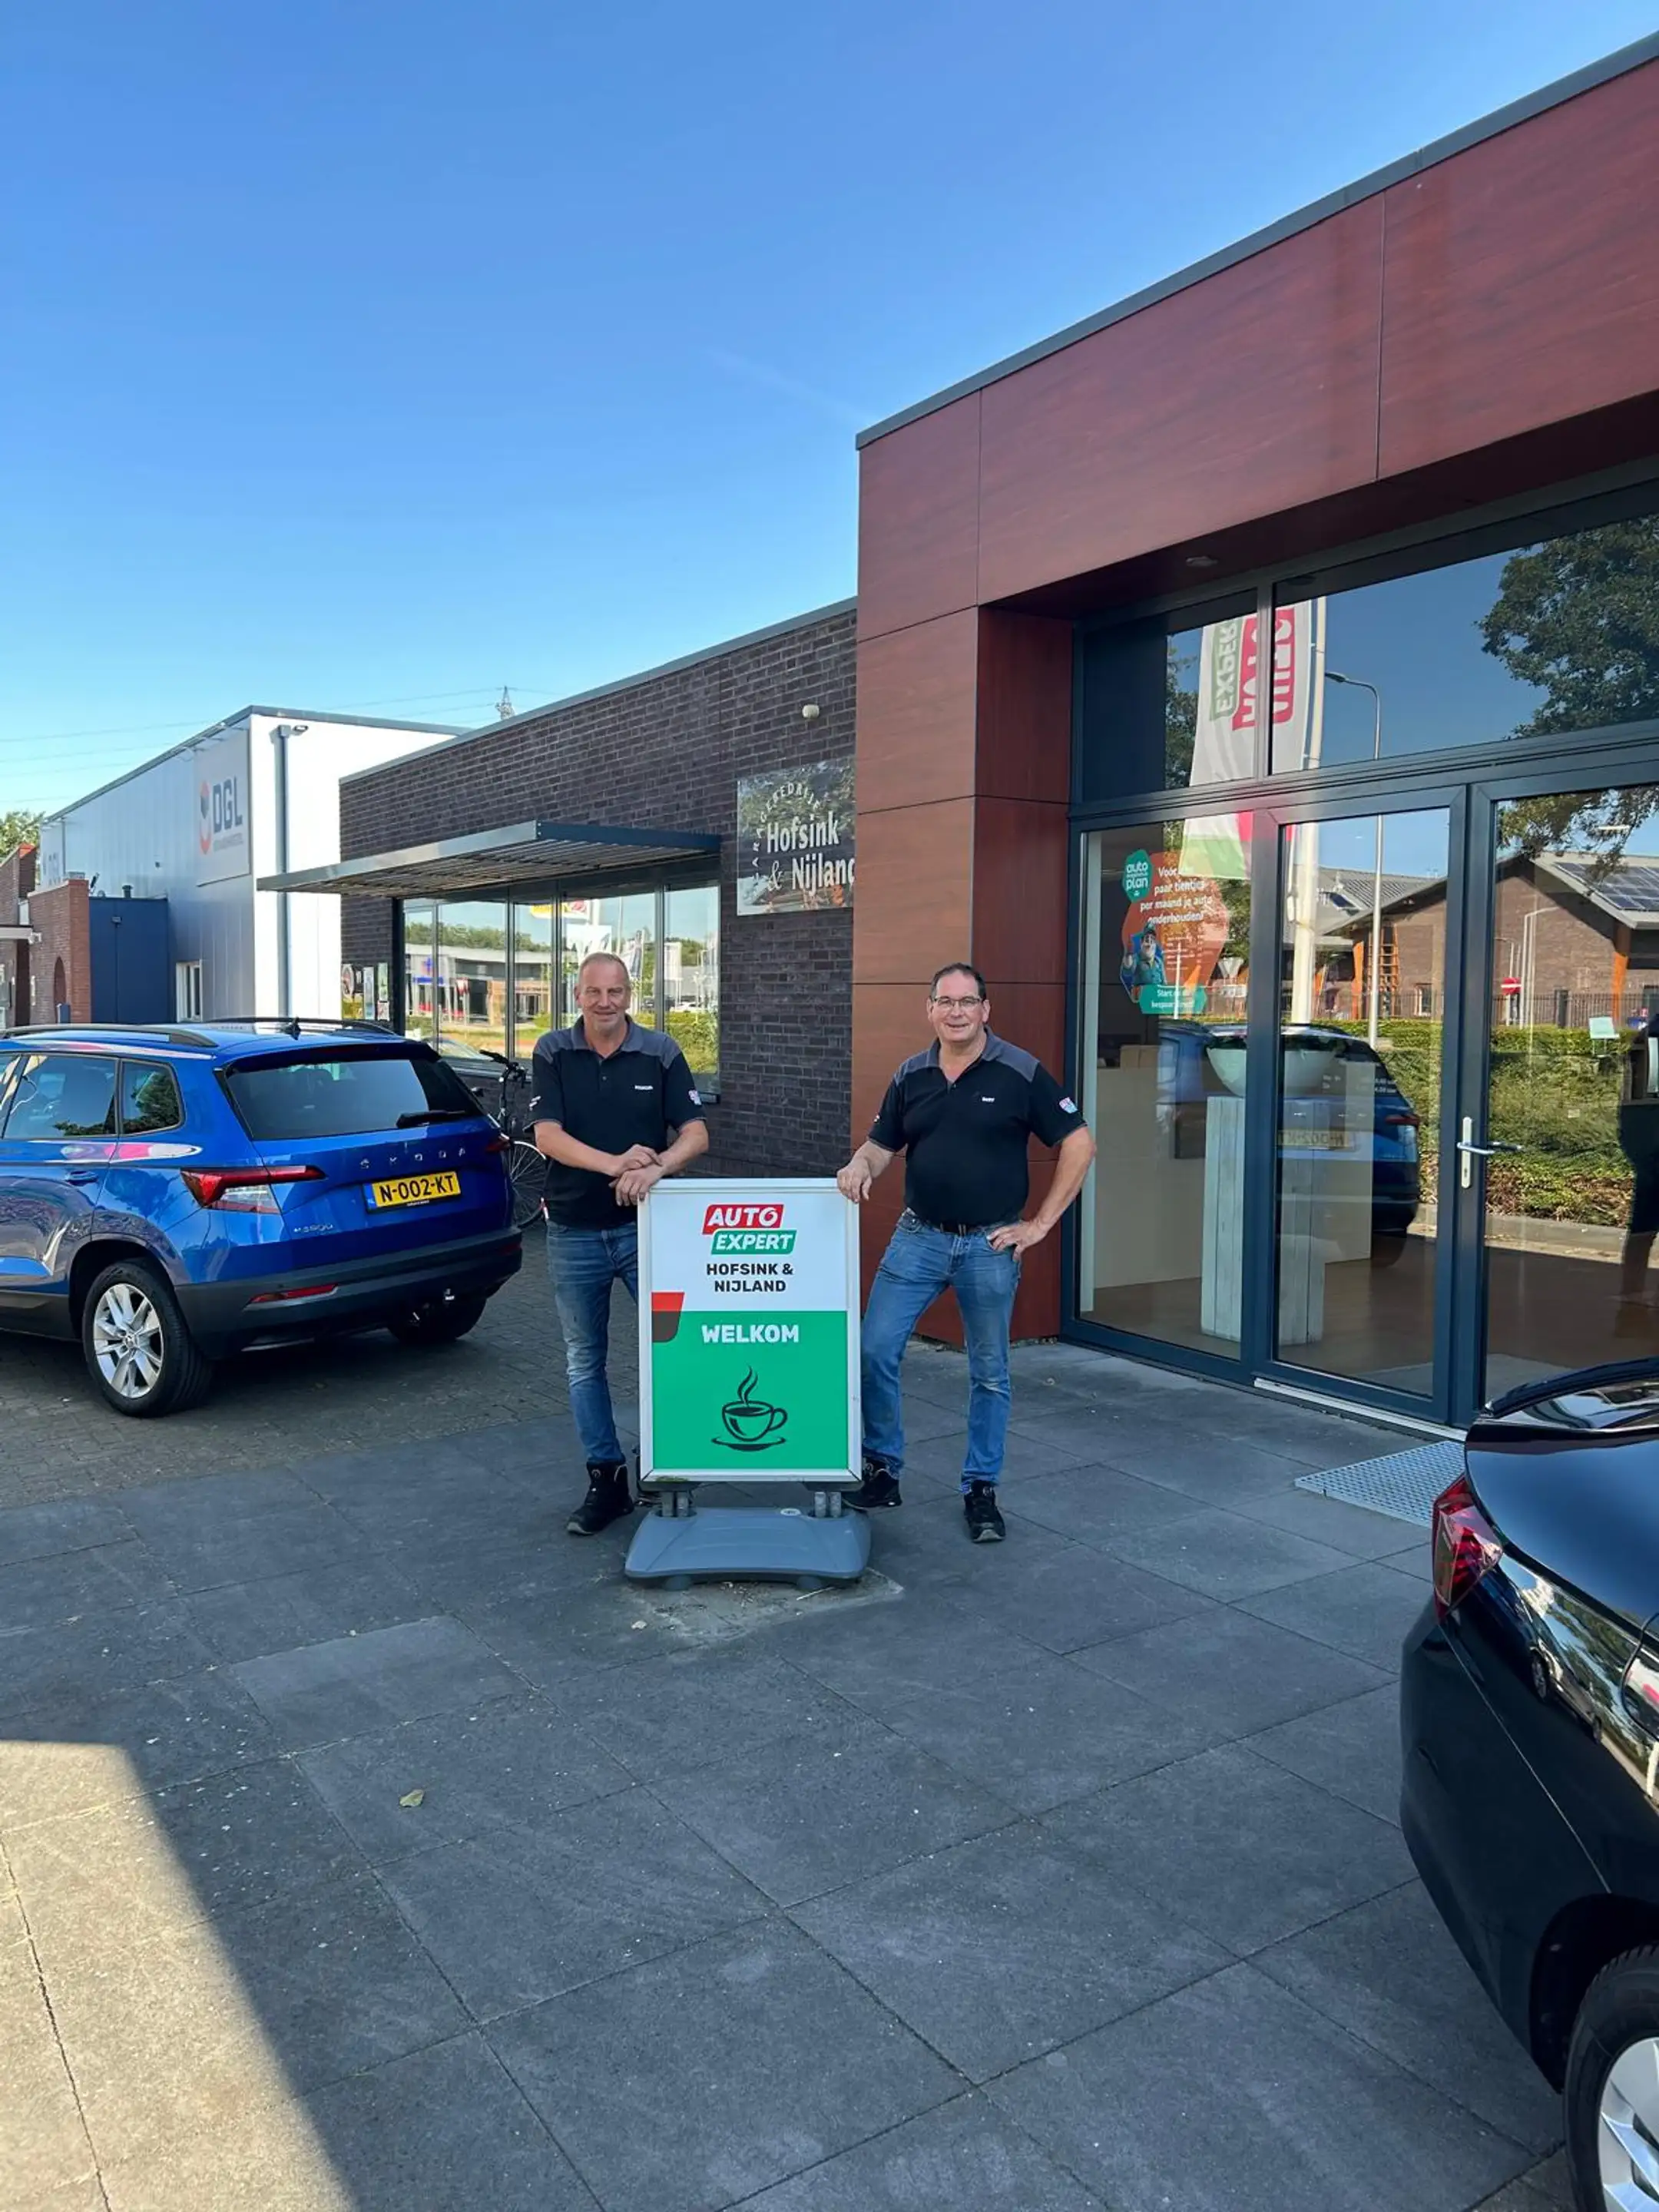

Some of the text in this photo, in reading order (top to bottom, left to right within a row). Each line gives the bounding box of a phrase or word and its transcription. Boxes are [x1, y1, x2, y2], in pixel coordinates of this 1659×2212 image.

[213, 776, 243, 834] DGL
[767, 810, 839, 853] Hofsink
[768, 860, 783, 892] &
[1126, 861, 1149, 873] auto
[1125, 877, 1149, 891] plan
[379, 1176, 454, 1203] N-002-KT
[707, 1207, 778, 1227] AUTO
[716, 1233, 793, 1250] EXPERT
[707, 1263, 793, 1275] HOFSINK &
[714, 1280, 786, 1292] NIJLAND
[702, 1325, 799, 1343] WELKOM
